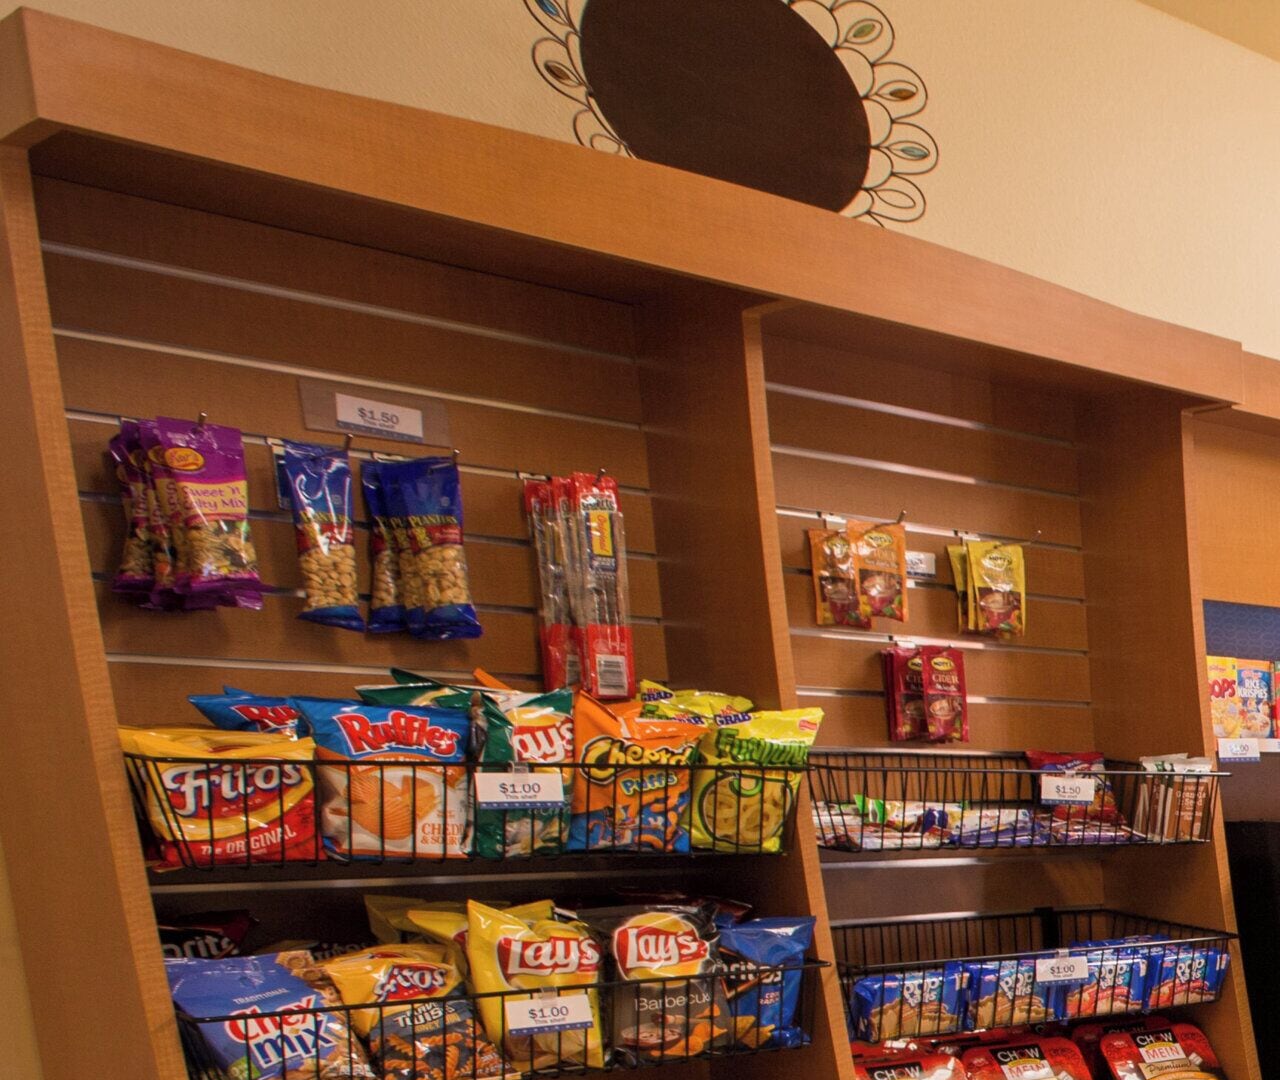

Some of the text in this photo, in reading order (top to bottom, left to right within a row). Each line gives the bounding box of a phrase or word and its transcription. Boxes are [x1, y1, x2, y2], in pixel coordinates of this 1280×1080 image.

[357, 406, 400, 425] $1.50
[221, 498, 247, 510] Mix
[1244, 679, 1261, 689] RICE
[1236, 686, 1268, 700] KRISPIES
[714, 712, 752, 727] GRAB
[333, 711, 460, 757] Ruffles
[513, 721, 574, 763] ay's
[163, 764, 303, 819] Fritos
[499, 781, 541, 795] $1.00
[620, 773, 678, 795] Puffs
[1055, 785, 1081, 795] $1.50
[626, 926, 700, 968] Lay's
[507, 936, 600, 976] Lay's
[1049, 964, 1076, 976] $1.00
[225, 995, 321, 1043] Chex
[528, 1004, 570, 1020] $1.00
[252, 1018, 337, 1069] mix
[1135, 1030, 1174, 1047] CHOW
[996, 1046, 1039, 1063] CHOW
[1144, 1043, 1181, 1060] MEIN
[1145, 1058, 1194, 1079] Premium
